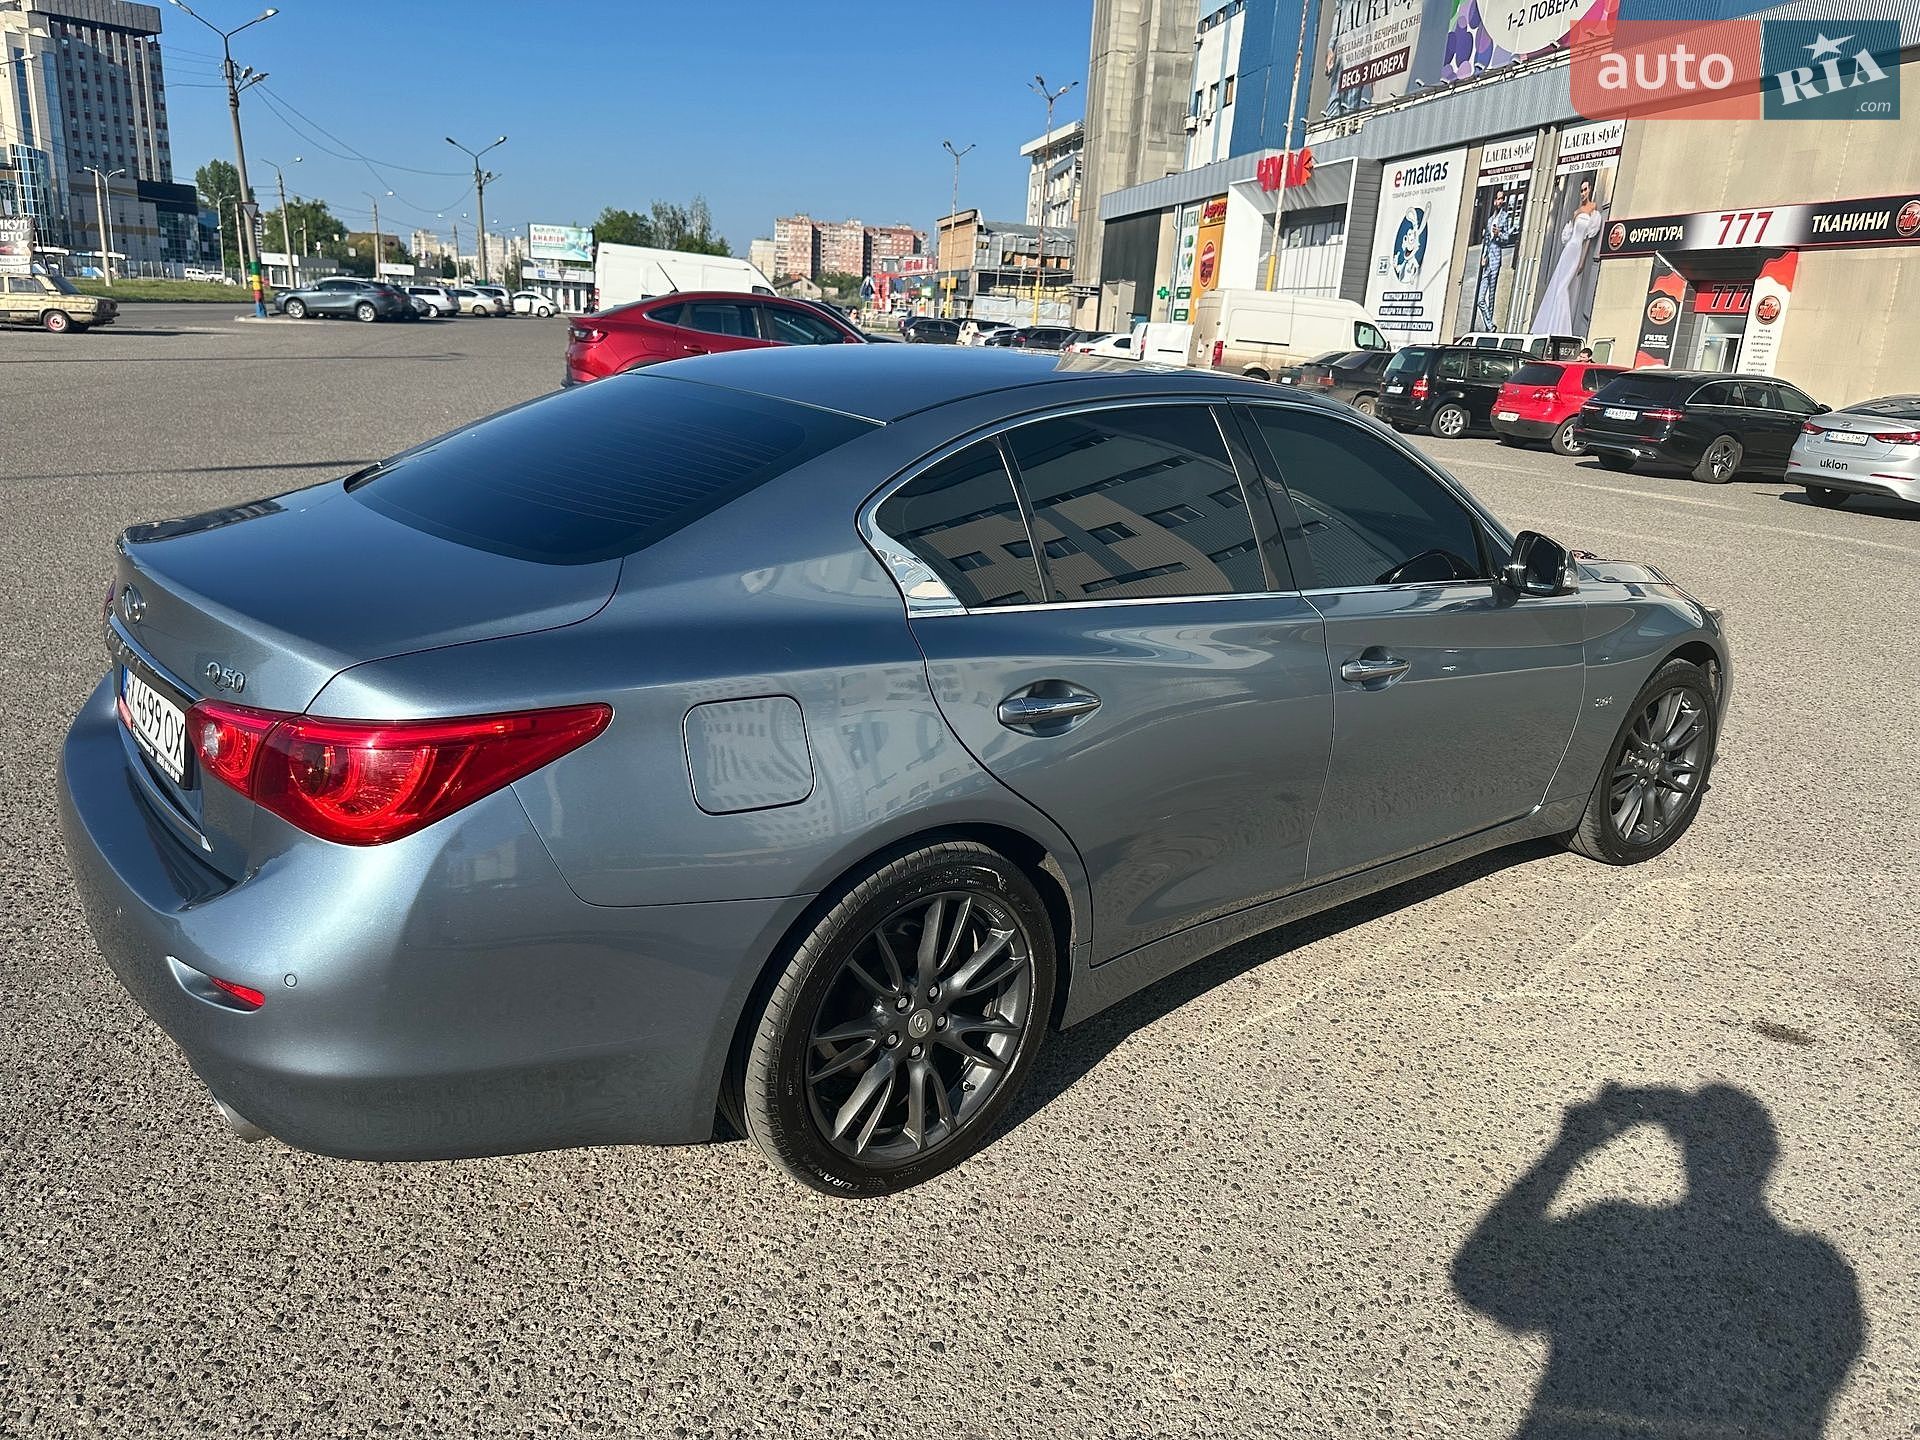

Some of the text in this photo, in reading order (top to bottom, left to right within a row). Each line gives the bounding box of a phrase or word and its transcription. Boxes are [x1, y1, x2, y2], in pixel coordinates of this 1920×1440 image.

[1507, 9, 1526, 31] 1-2
[1373, 32, 1408, 53] КОСТЮМИ
[1341, 69, 1361, 89] ВЕСЬ
[1369, 52, 1406, 79] ПОВЕРХ
[1564, 131, 1596, 149] LAURA
[1485, 145, 1513, 164] LAURA
[1569, 164, 1580, 172] ВЕСЬ
[1585, 160, 1604, 169] ПОВЕРХ
[0, 231, 24, 241] ВТО
[1629, 225, 1684, 243] ФУРНІТУРА
[1717, 211, 1774, 245] 777
[1811, 211, 1891, 232] ТКАНИНИ
[1711, 284, 1753, 310] 777
[1820, 459, 1848, 470] uklon
[205, 662, 246, 693] Q50
[138, 680, 161, 741] 4699
[165, 709, 185, 769] OX
